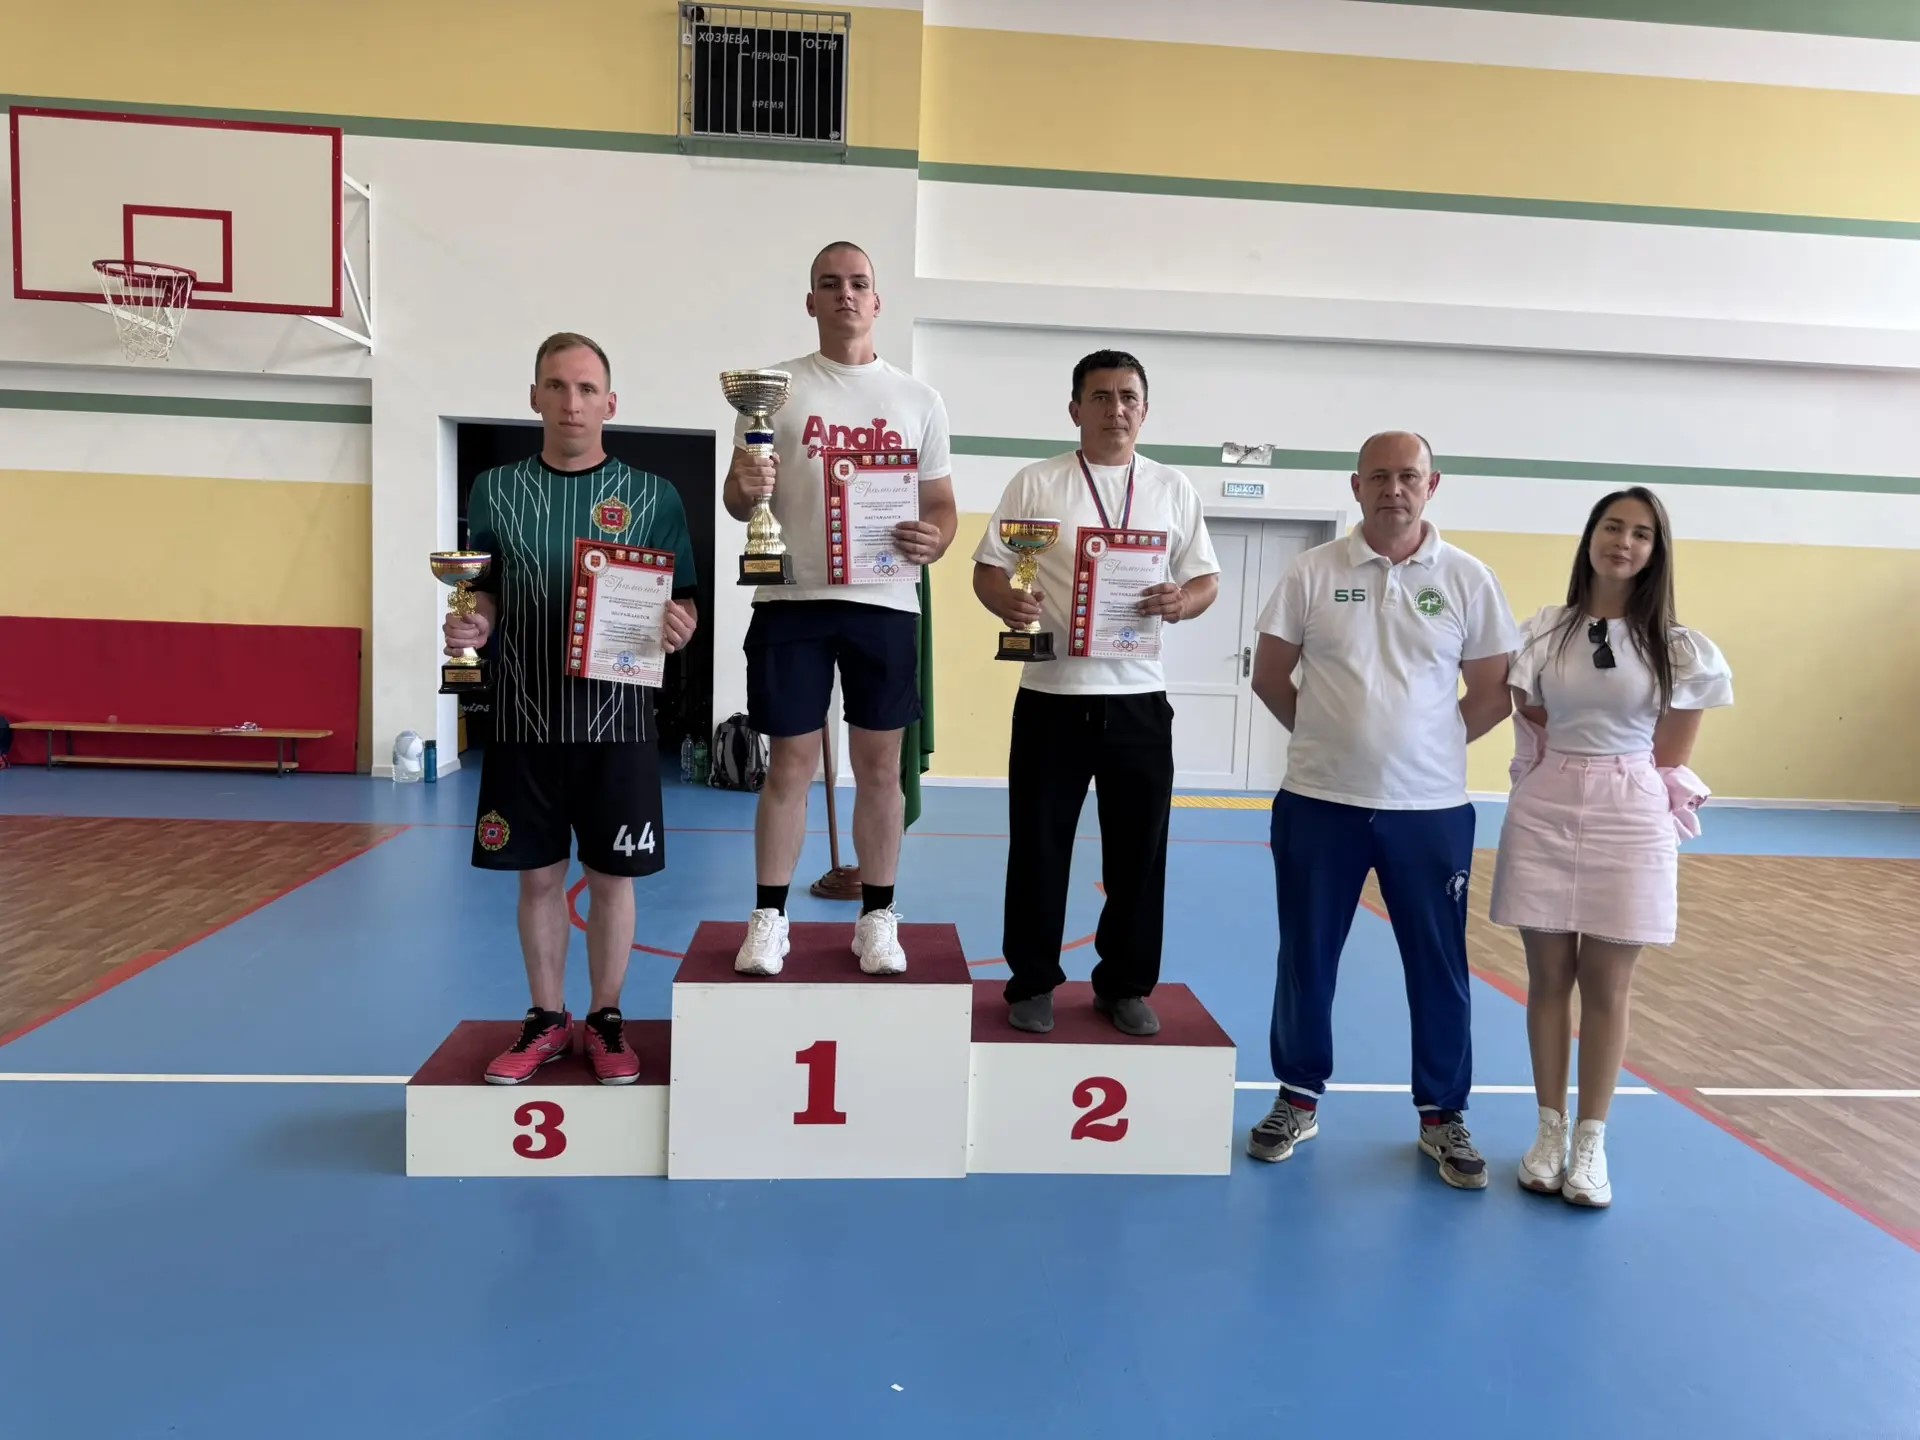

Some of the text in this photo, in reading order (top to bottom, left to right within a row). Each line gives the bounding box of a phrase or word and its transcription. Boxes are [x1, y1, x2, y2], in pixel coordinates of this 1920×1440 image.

[698, 32, 750, 45] ХОЗЯЕВА
[801, 38, 837, 50] ГОСТИ
[751, 51, 787, 62] ПЕРИОД
[752, 100, 784, 110] ВРЕМЯ
[1228, 484, 1262, 495] ВЫХОД
[1334, 588, 1366, 602] 55
[612, 821, 656, 857] 44
[793, 1040, 847, 1125] 1
[1070, 1076, 1129, 1142] 2
[512, 1100, 568, 1160] 3
